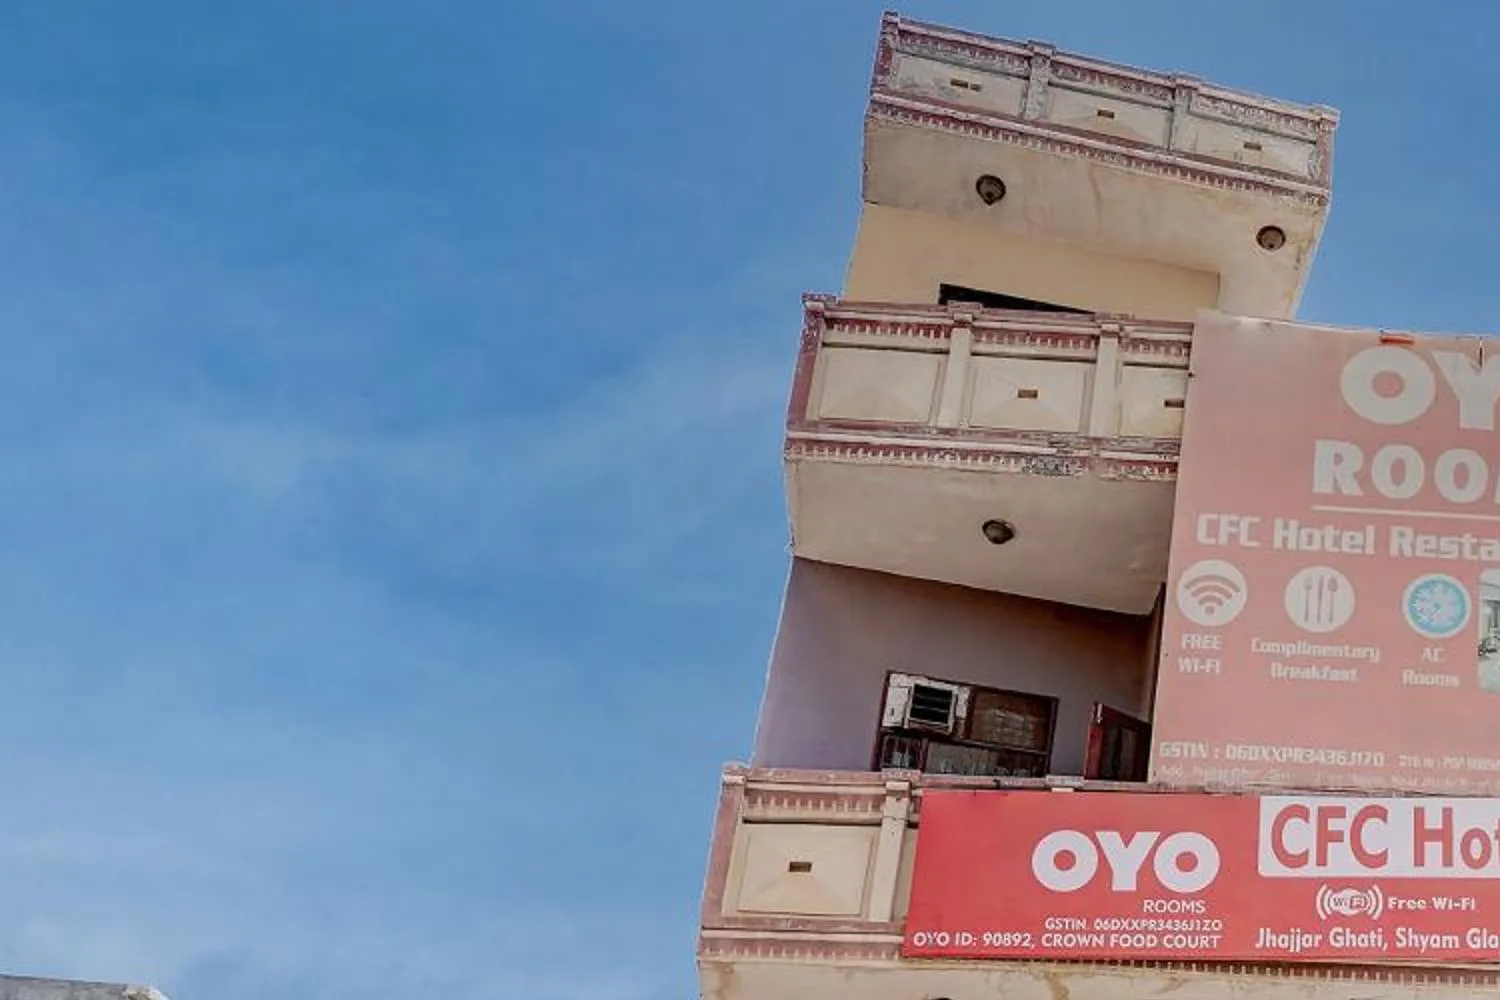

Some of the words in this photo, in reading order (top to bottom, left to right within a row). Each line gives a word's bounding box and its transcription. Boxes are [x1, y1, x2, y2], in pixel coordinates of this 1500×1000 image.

[1197, 514, 1261, 548] CFC
[1274, 523, 1375, 556] Hotel
[1181, 634, 1223, 651] FREE
[1251, 637, 1381, 663] Complimentary
[1421, 648, 1445, 664] AC
[1271, 661, 1359, 682] Breakfast
[1402, 669, 1460, 688] Rooms
[1271, 804, 1390, 869] CFC
[1032, 829, 1220, 893] OYO
[1143, 900, 1206, 914] ROOMS
[1388, 897, 1427, 910] Free
[913, 932, 949, 947] OYO
[956, 932, 978, 947] ID:
[983, 932, 1035, 950] 90892,
[1041, 934, 1105, 949] CROWN
[1110, 934, 1158, 949] FOOD
[1163, 935, 1222, 950] COURT
[1256, 927, 1322, 952] Jhajjar
[1329, 926, 1388, 951] Ghati,
[1395, 928, 1460, 953] Shyam
